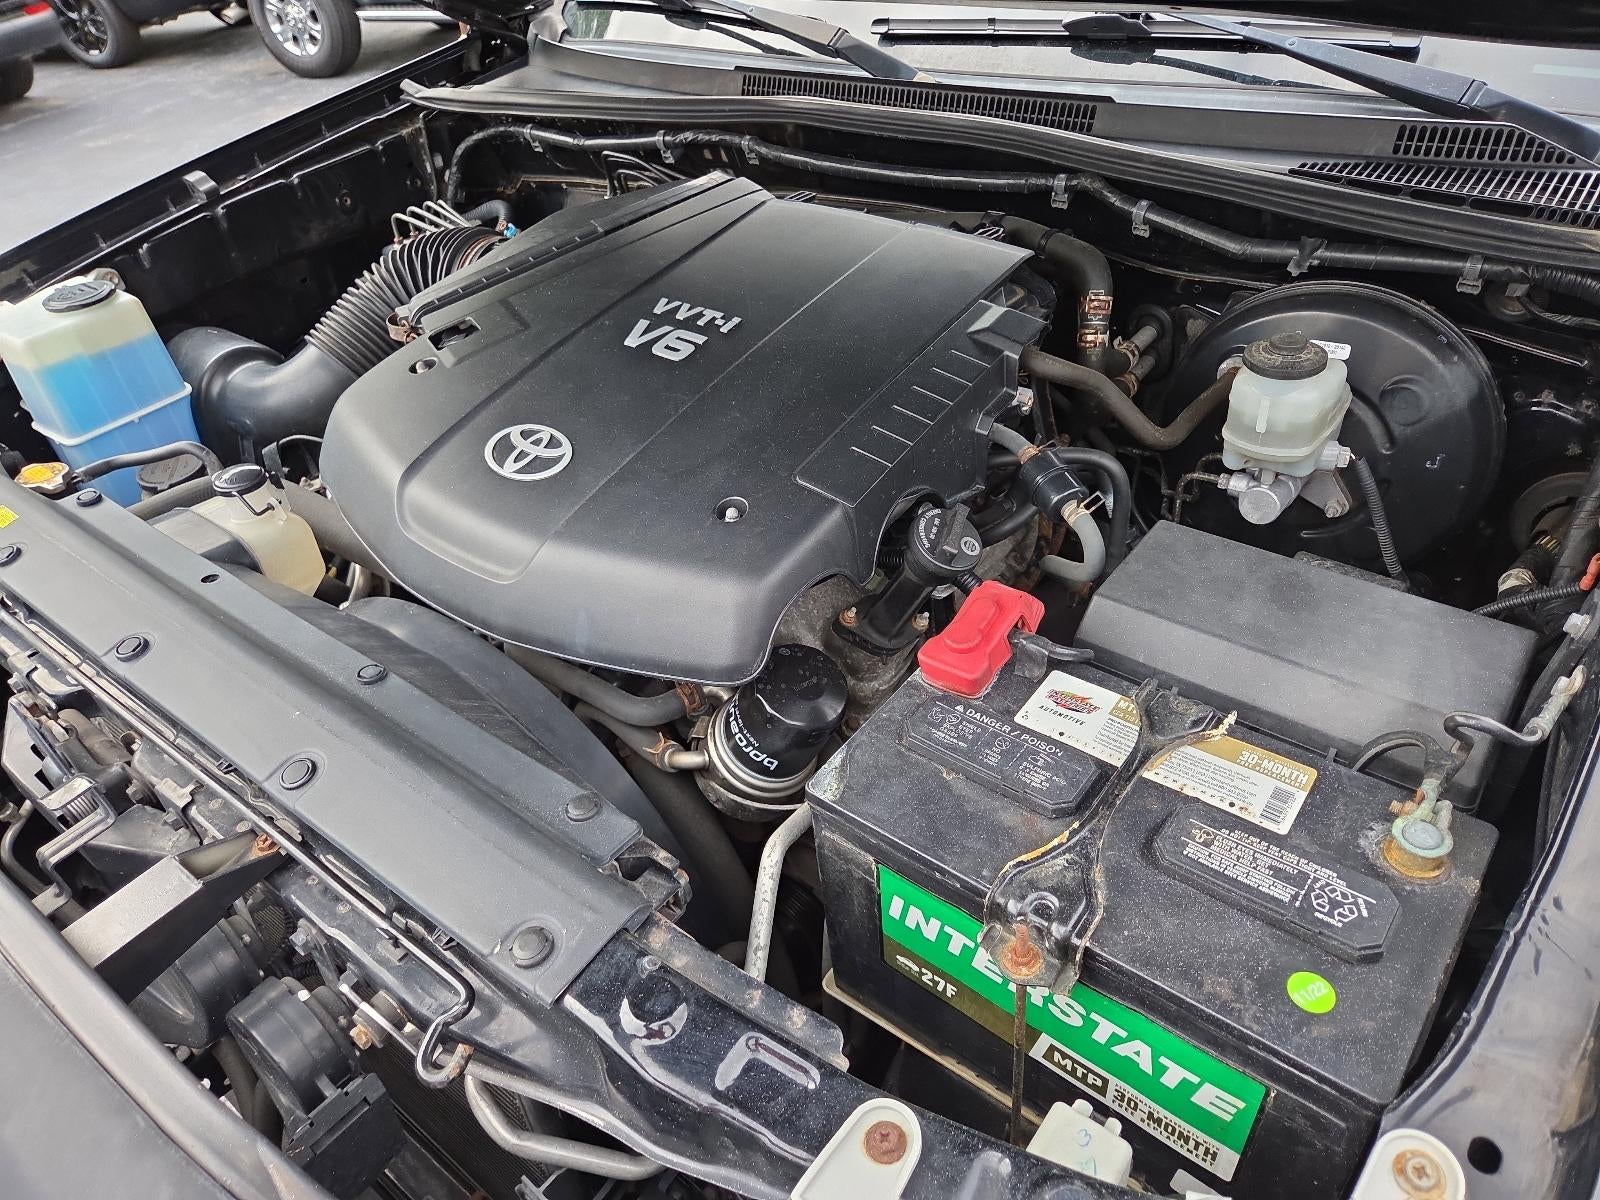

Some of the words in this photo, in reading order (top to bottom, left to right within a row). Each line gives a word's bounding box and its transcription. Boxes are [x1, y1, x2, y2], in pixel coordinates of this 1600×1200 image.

[624, 318, 709, 361] V6
[1038, 705, 1086, 726] AUTOMOTIVE
[1117, 700, 1137, 713] MT
[961, 721, 982, 732] SHIELD
[966, 709, 1011, 735] DANGER
[1021, 733, 1063, 757] POISON
[1239, 750, 1309, 785] 30-MONTH
[1256, 767, 1304, 789] REPLACEMENT
[1210, 844, 1238, 861] MEDICAL
[1239, 858, 1257, 868] HELP
[1257, 866, 1274, 875] FAST
[1214, 840, 1231, 851] WITH
[1257, 860, 1269, 868] GET
[1215, 835, 1237, 848] FLUSH
[1237, 845, 1254, 855] EYES
[1254, 852, 1299, 875] IMMEDIATELY
[1273, 882, 1296, 895] FOLLOW
[1329, 876, 1347, 887] LEVEL
[921, 967, 957, 998] 27F
[1053, 1051, 1103, 1087] MTP
[1113, 1088, 1218, 1163] 30-MONTH
[1115, 1083, 1160, 1115] PERFORMANCE
[1164, 1115, 1200, 1139] WARRANTY
[1202, 1138, 1220, 1151] WITH
[1112, 1099, 1135, 1117] FREE
[1140, 1117, 1214, 1167] REPLACEMENT
